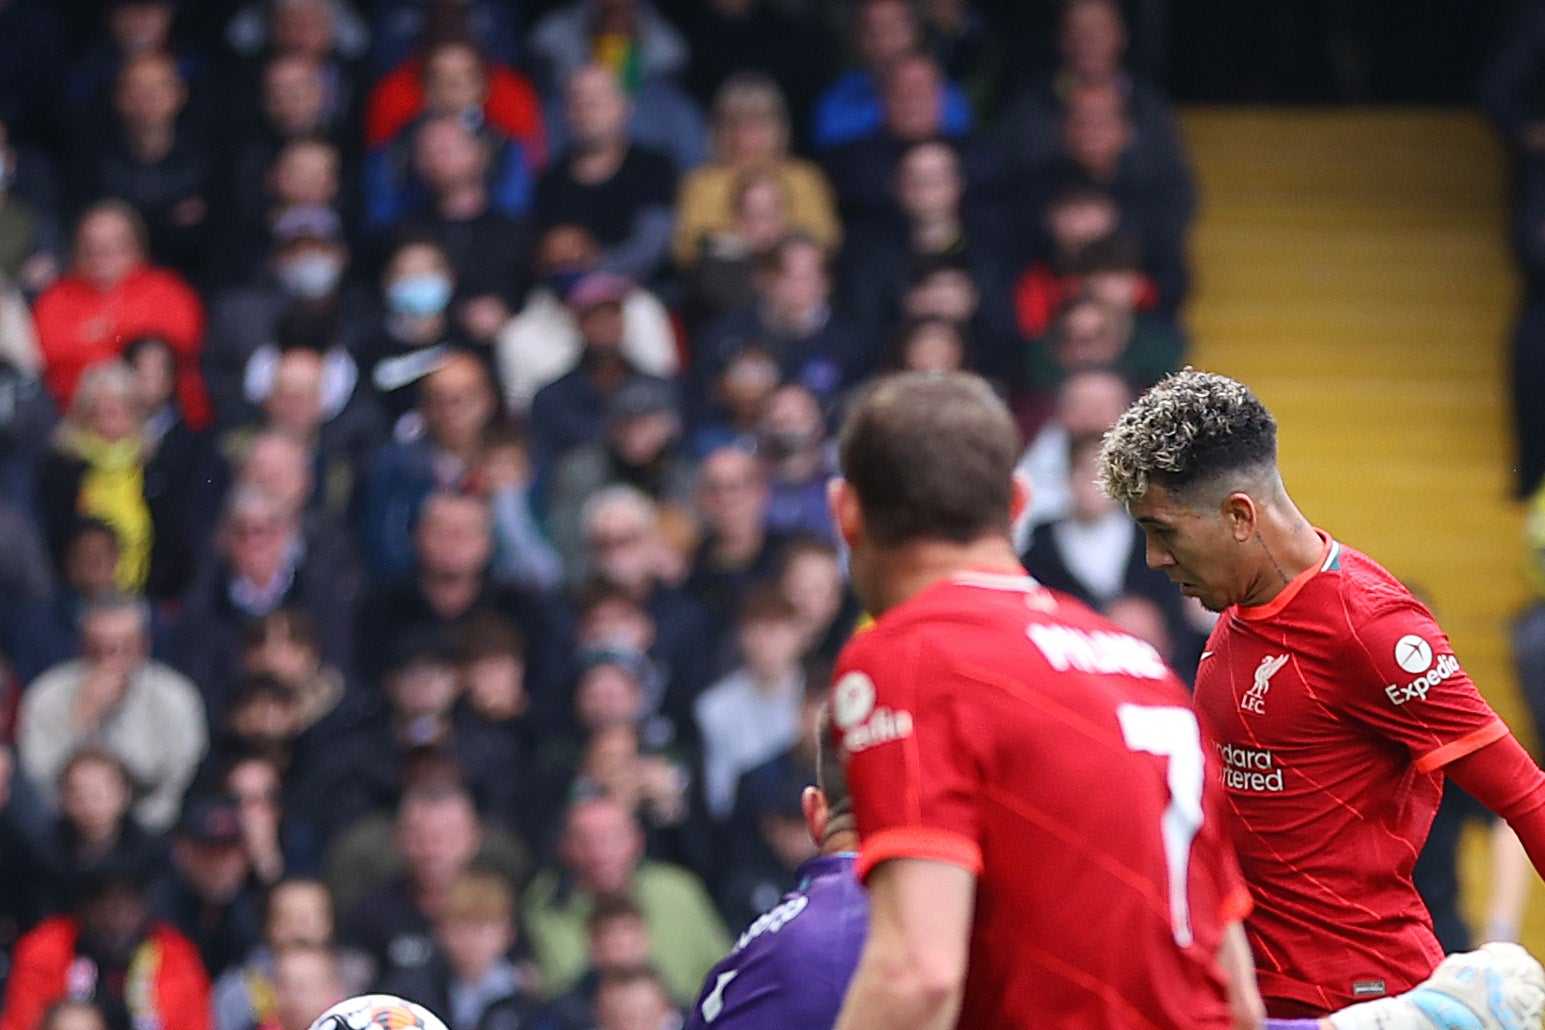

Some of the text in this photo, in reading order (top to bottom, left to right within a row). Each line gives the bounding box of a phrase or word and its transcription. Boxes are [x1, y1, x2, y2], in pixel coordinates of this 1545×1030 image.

[1384, 654, 1460, 706] Expedia
[1241, 694, 1266, 715] LFC
[1221, 768, 1284, 791] rtered
[1116, 702, 1206, 948] 7
